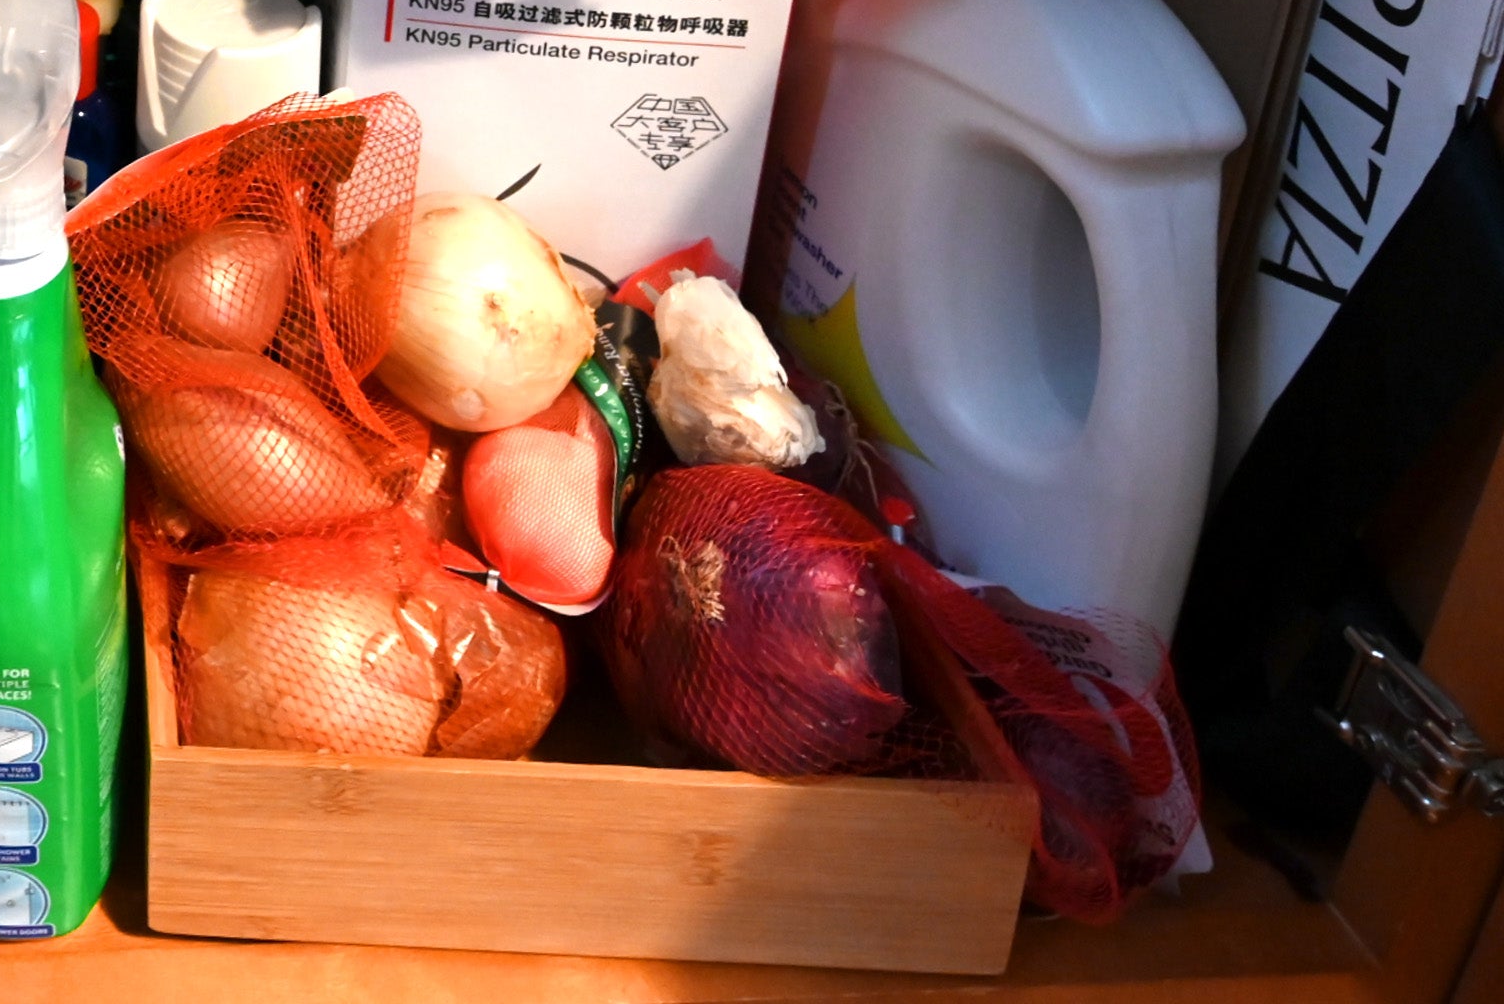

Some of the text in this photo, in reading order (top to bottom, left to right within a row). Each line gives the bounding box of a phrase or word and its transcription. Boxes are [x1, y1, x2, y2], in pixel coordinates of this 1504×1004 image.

[473, 0, 750, 38] 自吸过滤式防颗粒物呼吸器
[405, 27, 700, 69] KN95 Particulate Respirator
[636, 98, 711, 116] 中国
[617, 115, 721, 133] 大客户
[638, 131, 696, 151] 专享
[2, 668, 30, 678] FOR
